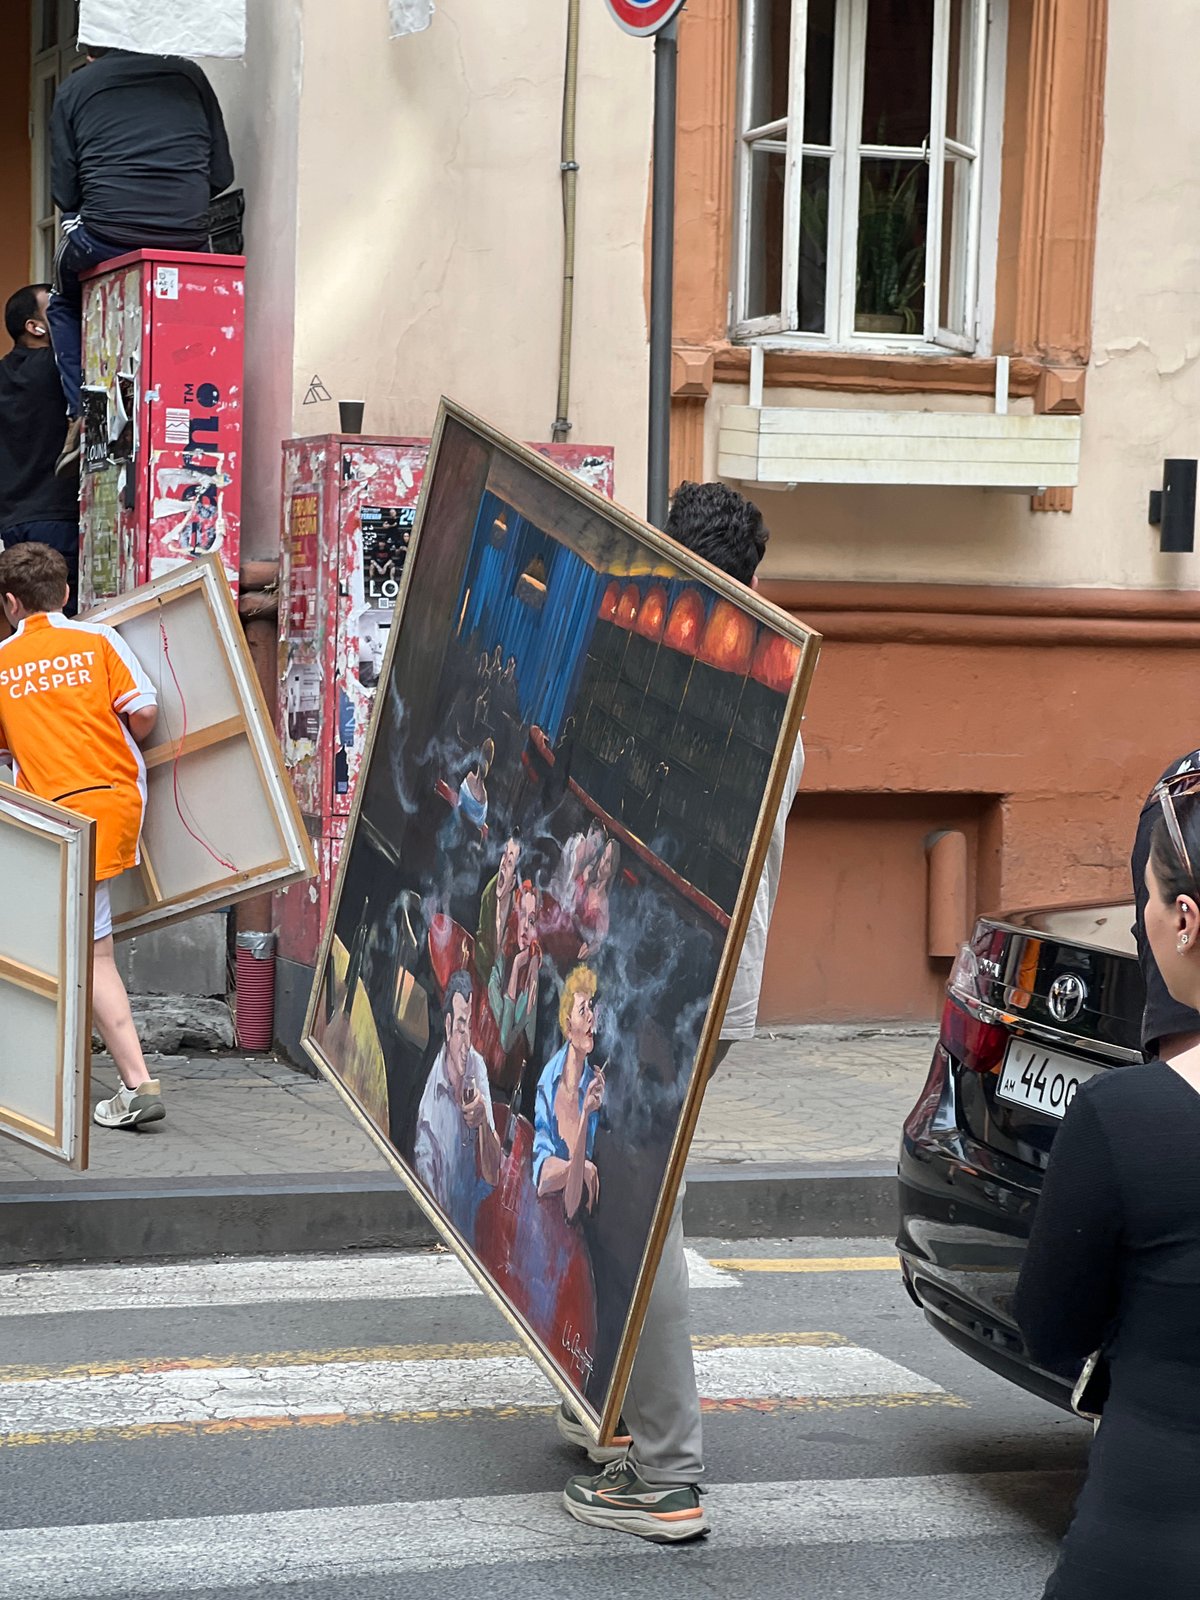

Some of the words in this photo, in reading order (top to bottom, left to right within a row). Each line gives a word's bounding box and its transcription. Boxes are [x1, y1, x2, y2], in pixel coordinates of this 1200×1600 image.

[183, 383, 194, 404] TM
[0, 653, 95, 685] SUPPORT
[9, 669, 92, 698] CASPER
[1003, 1078, 1017, 1093] AM
